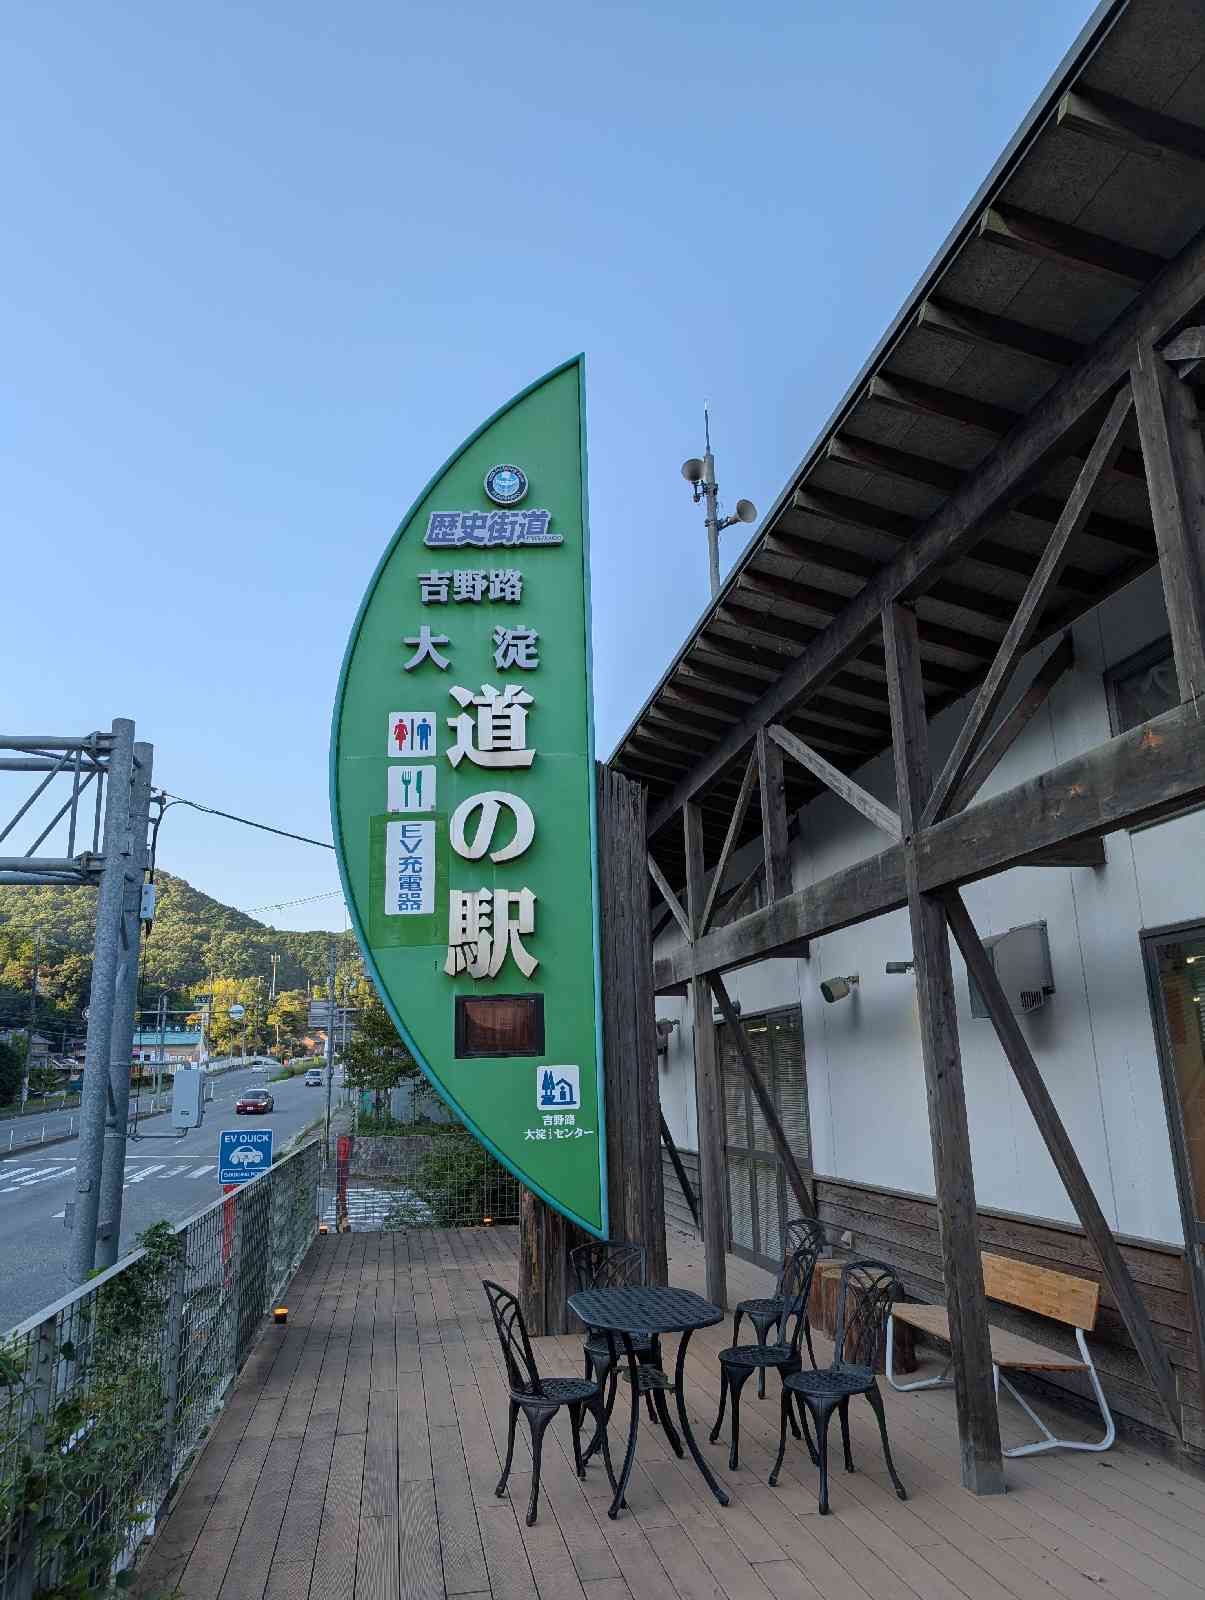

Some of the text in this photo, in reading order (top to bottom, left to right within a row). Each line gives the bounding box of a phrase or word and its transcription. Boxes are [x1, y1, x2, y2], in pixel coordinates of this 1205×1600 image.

[427, 510, 550, 544] 歴史街道
[418, 569, 523, 603] 吉野路
[444, 682, 538, 980] 道の駅
[397, 823, 423, 912] EV充電器
[224, 1134, 270, 1143] EV QUICK
